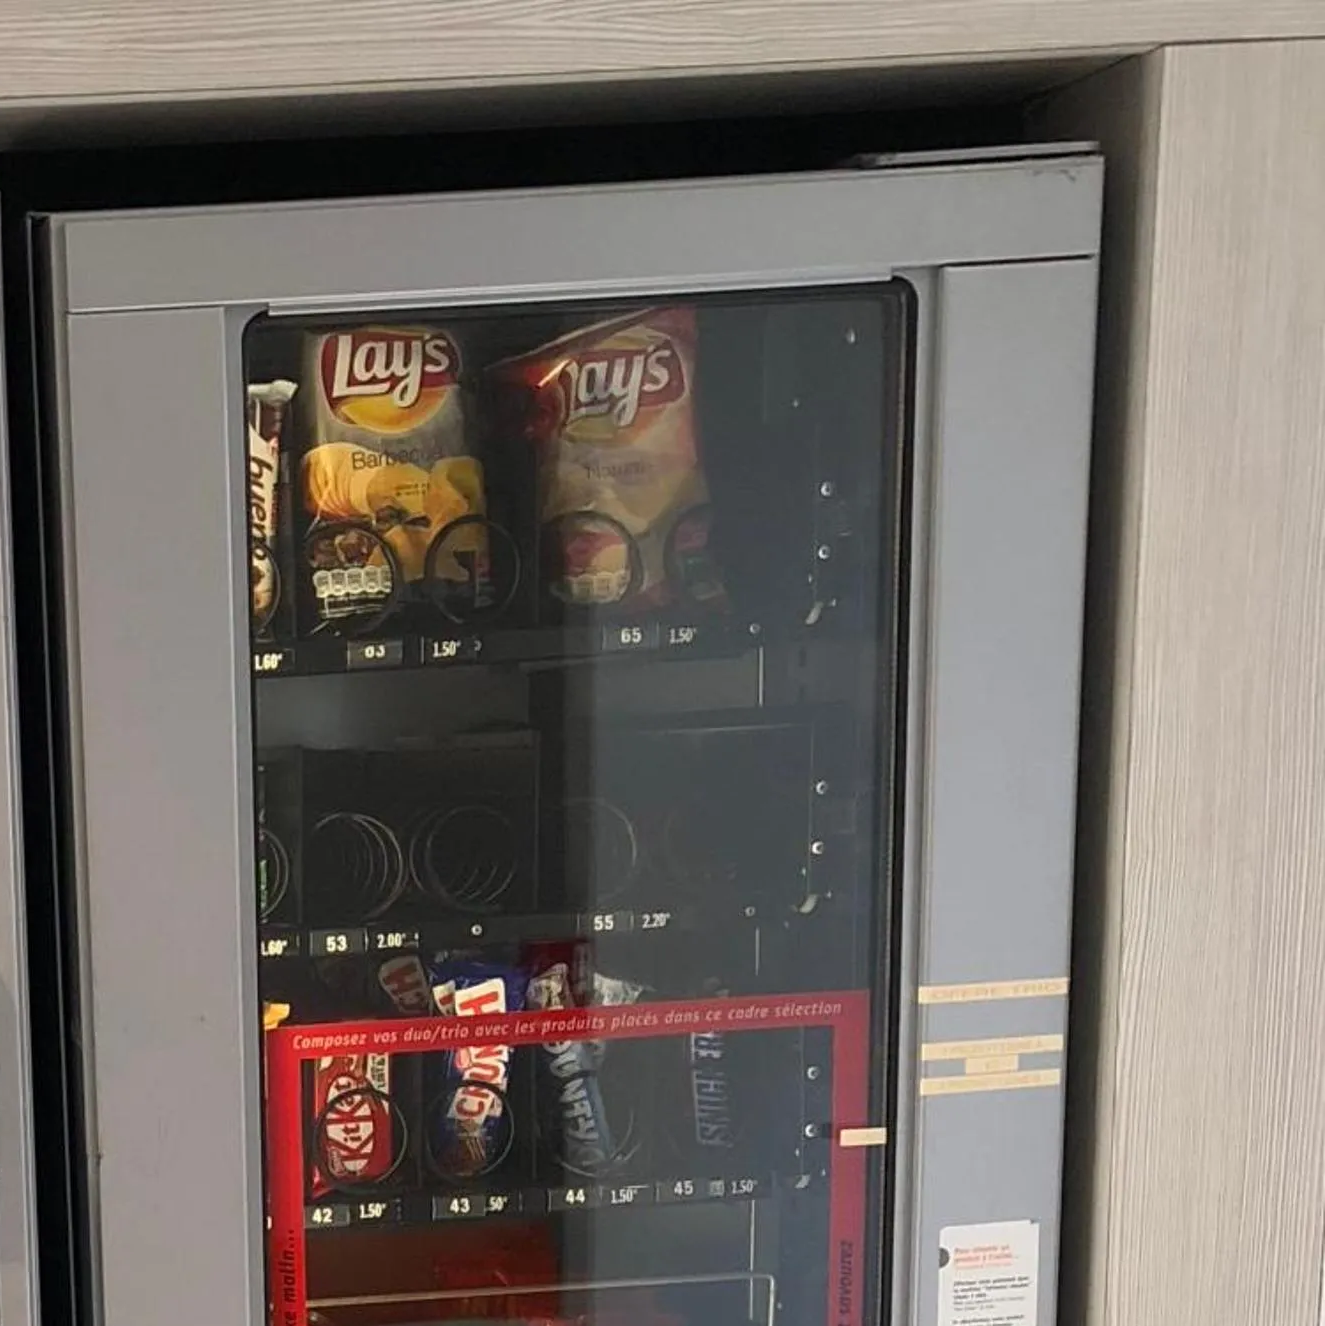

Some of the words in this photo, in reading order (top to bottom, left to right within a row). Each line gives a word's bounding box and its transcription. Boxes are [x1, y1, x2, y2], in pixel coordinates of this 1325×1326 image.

[331, 333, 450, 408] Lay's
[620, 627, 642, 644] 65
[593, 913, 614, 931] 55
[325, 934, 348, 952] 53
[292, 1031, 368, 1050] Composez
[373, 1029, 398, 1044] vos
[403, 1022, 469, 1043] duo/trio
[475, 1022, 512, 1038] avec
[514, 1019, 538, 1034] les
[540, 1016, 606, 1037] produits
[610, 1012, 658, 1034] placés
[664, 1008, 700, 1025] dans
[704, 1008, 722, 1022] ce
[727, 1004, 770, 1022] cadre
[773, 1001, 843, 1018] sélection
[565, 1188, 586, 1204] 44
[673, 1180, 694, 1196] 45
[449, 1198, 471, 1214] 43
[311, 1208, 333, 1224] 42
